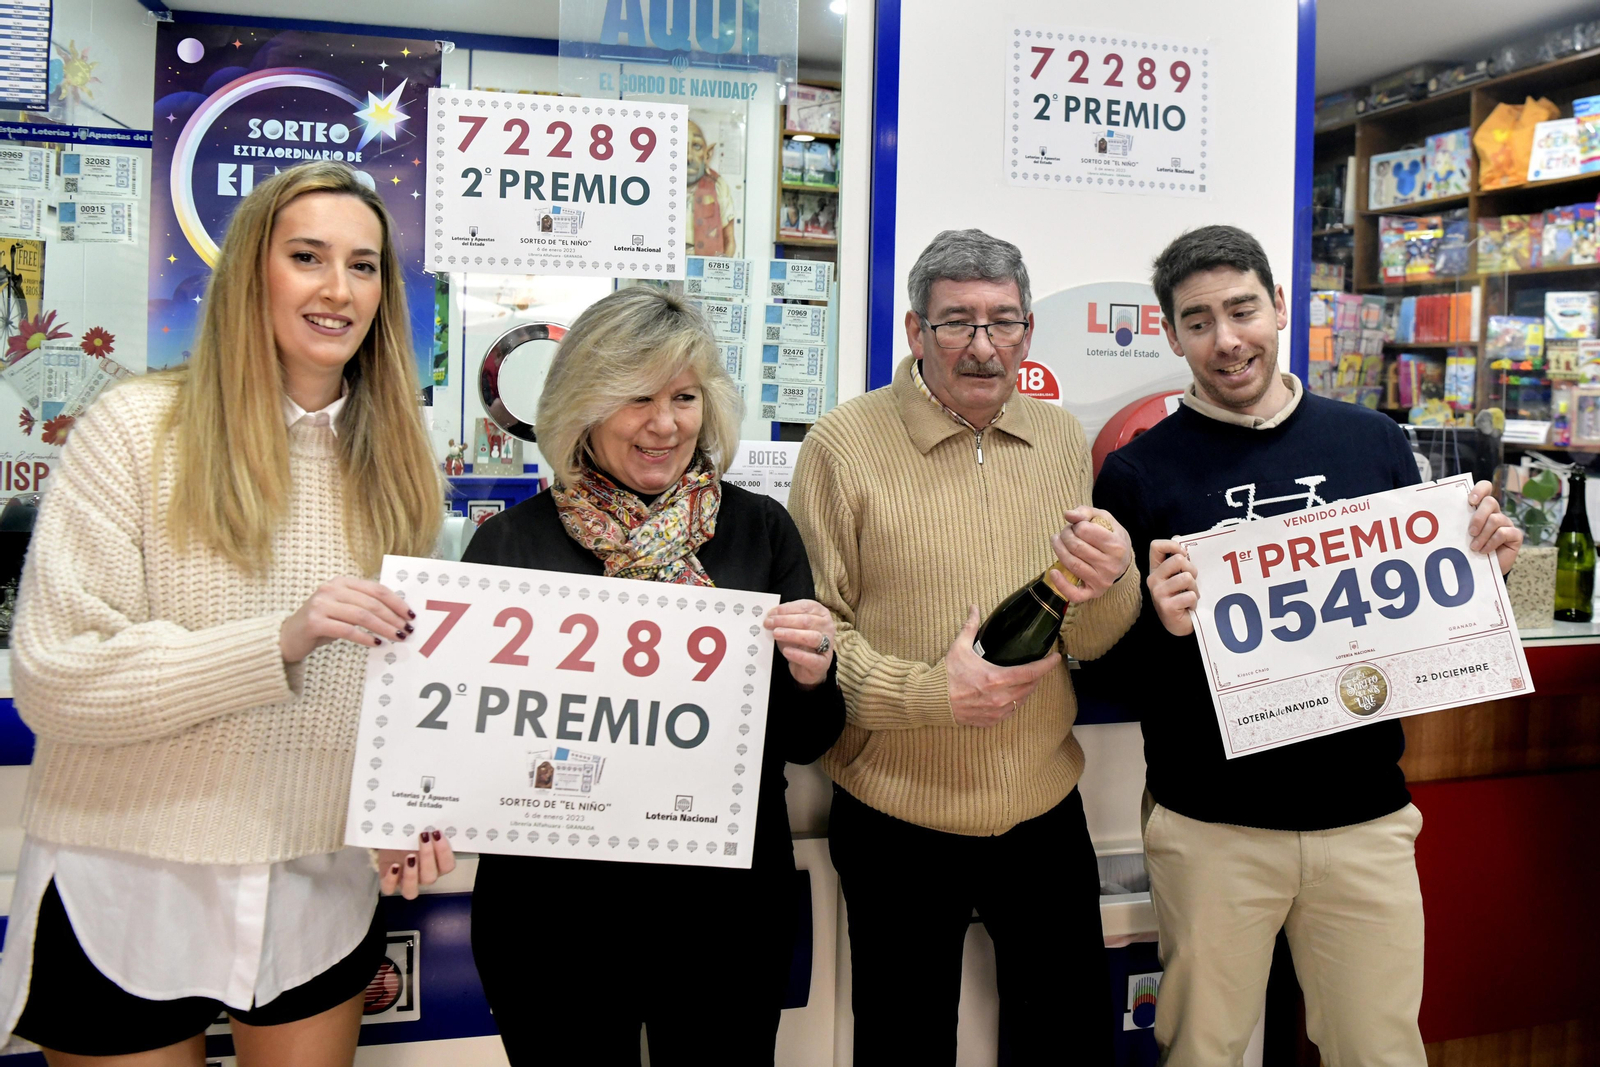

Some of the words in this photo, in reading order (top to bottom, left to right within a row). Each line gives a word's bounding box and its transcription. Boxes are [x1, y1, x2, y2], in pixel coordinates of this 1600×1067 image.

[1030, 46, 1191, 93] 72289
[600, 73, 615, 91] EL
[620, 74, 665, 94] GORDO
[669, 77, 686, 96] DE
[690, 78, 758, 100] NAVIDAD?
[1064, 95, 1186, 132] PREMIO
[88, 131, 131, 140] Apuestas
[248, 118, 349, 144] SORTEO
[457, 115, 657, 163] 72289
[85, 158, 110, 166] 32083
[233, 145, 343, 161] EXTRAORDINARIO
[347, 151, 362, 163] DE
[217, 163, 254, 197] EL
[499, 169, 650, 206] PREMIO
[19, 250, 37, 267] FREE
[708, 262, 730, 270] 67815
[706, 305, 728, 313] 72462
[787, 309, 807, 317] 70969
[783, 348, 804, 356] 92476
[1120, 349, 1131, 357] del
[1134, 349, 1160, 358] Estado
[783, 388, 804, 396] 33833
[749, 450, 787, 465] BOTES
[0, 461, 50, 491] ISP
[1283, 508, 1337, 527] VENDIDO
[1341, 499, 1371, 515] AQUÍ
[1257, 510, 1439, 578] PREMIO
[1214, 547, 1475, 654] 05490
[1449, 621, 1477, 632] GRANADA
[418, 599, 728, 682] 72289
[1354, 648, 1375, 656] NACIONAL
[1415, 675, 1428, 684] 22
[1431, 663, 1490, 681] DICIEMBRE
[474, 685, 710, 749] PREMIO
[428, 794, 459, 802] Apuestas
[499, 797, 541, 808] SORTEO
[543, 800, 556, 809] DE
[531, 811, 541, 819] de
[566, 814, 585, 822] 2023
[646, 812, 678, 821] Lotería
[680, 814, 718, 823] Nacional
